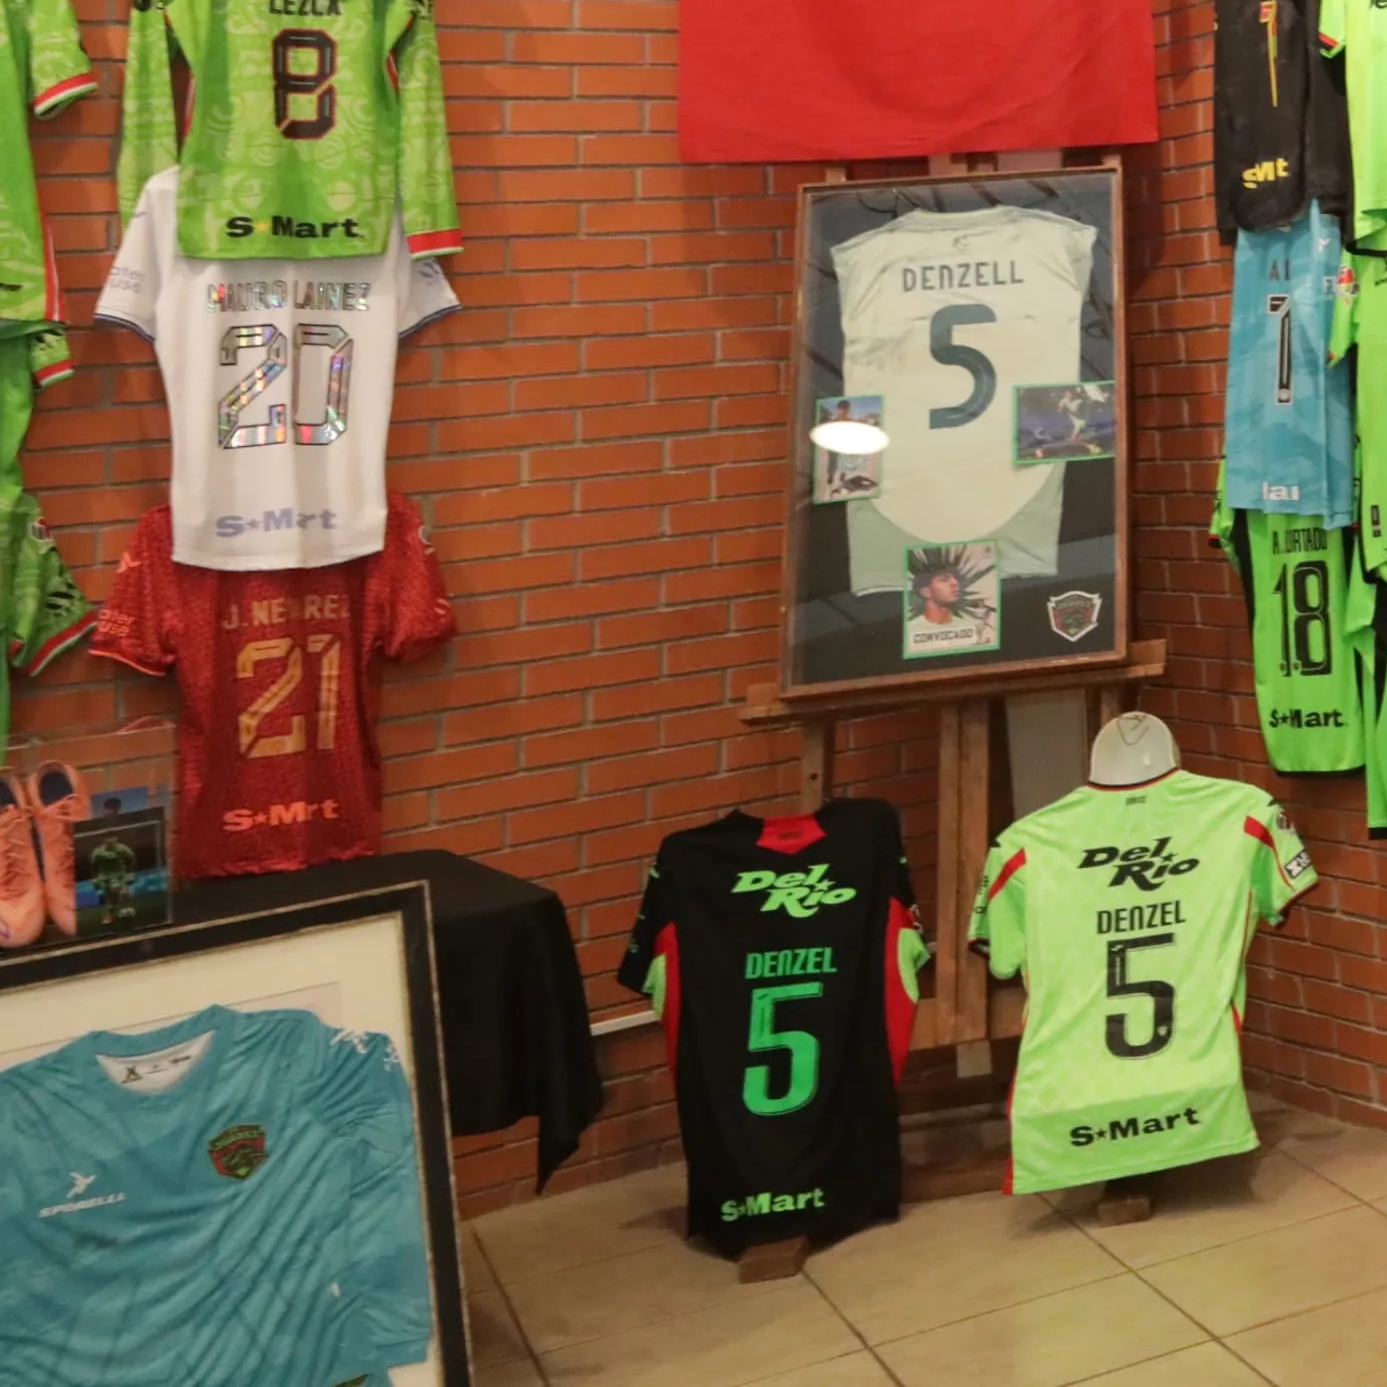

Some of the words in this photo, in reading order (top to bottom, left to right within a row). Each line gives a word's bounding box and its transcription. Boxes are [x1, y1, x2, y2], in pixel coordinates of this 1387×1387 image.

[271, 29, 337, 140] 8
[902, 259, 1024, 292] DENZELL
[218, 321, 353, 450] 20
[929, 303, 997, 430] 5
[1273, 559, 1333, 677] 18
[237, 634, 341, 758] 21
[730, 863, 830, 896] Del
[1077, 836, 1175, 870] Del
[1108, 852, 1199, 892] Rio
[761, 882, 857, 918] Rio
[1097, 899, 1187, 935] DENZEL
[745, 946, 838, 979] DENZEL
[1104, 931, 1177, 1060] 5
[742, 981, 825, 1115] 5
